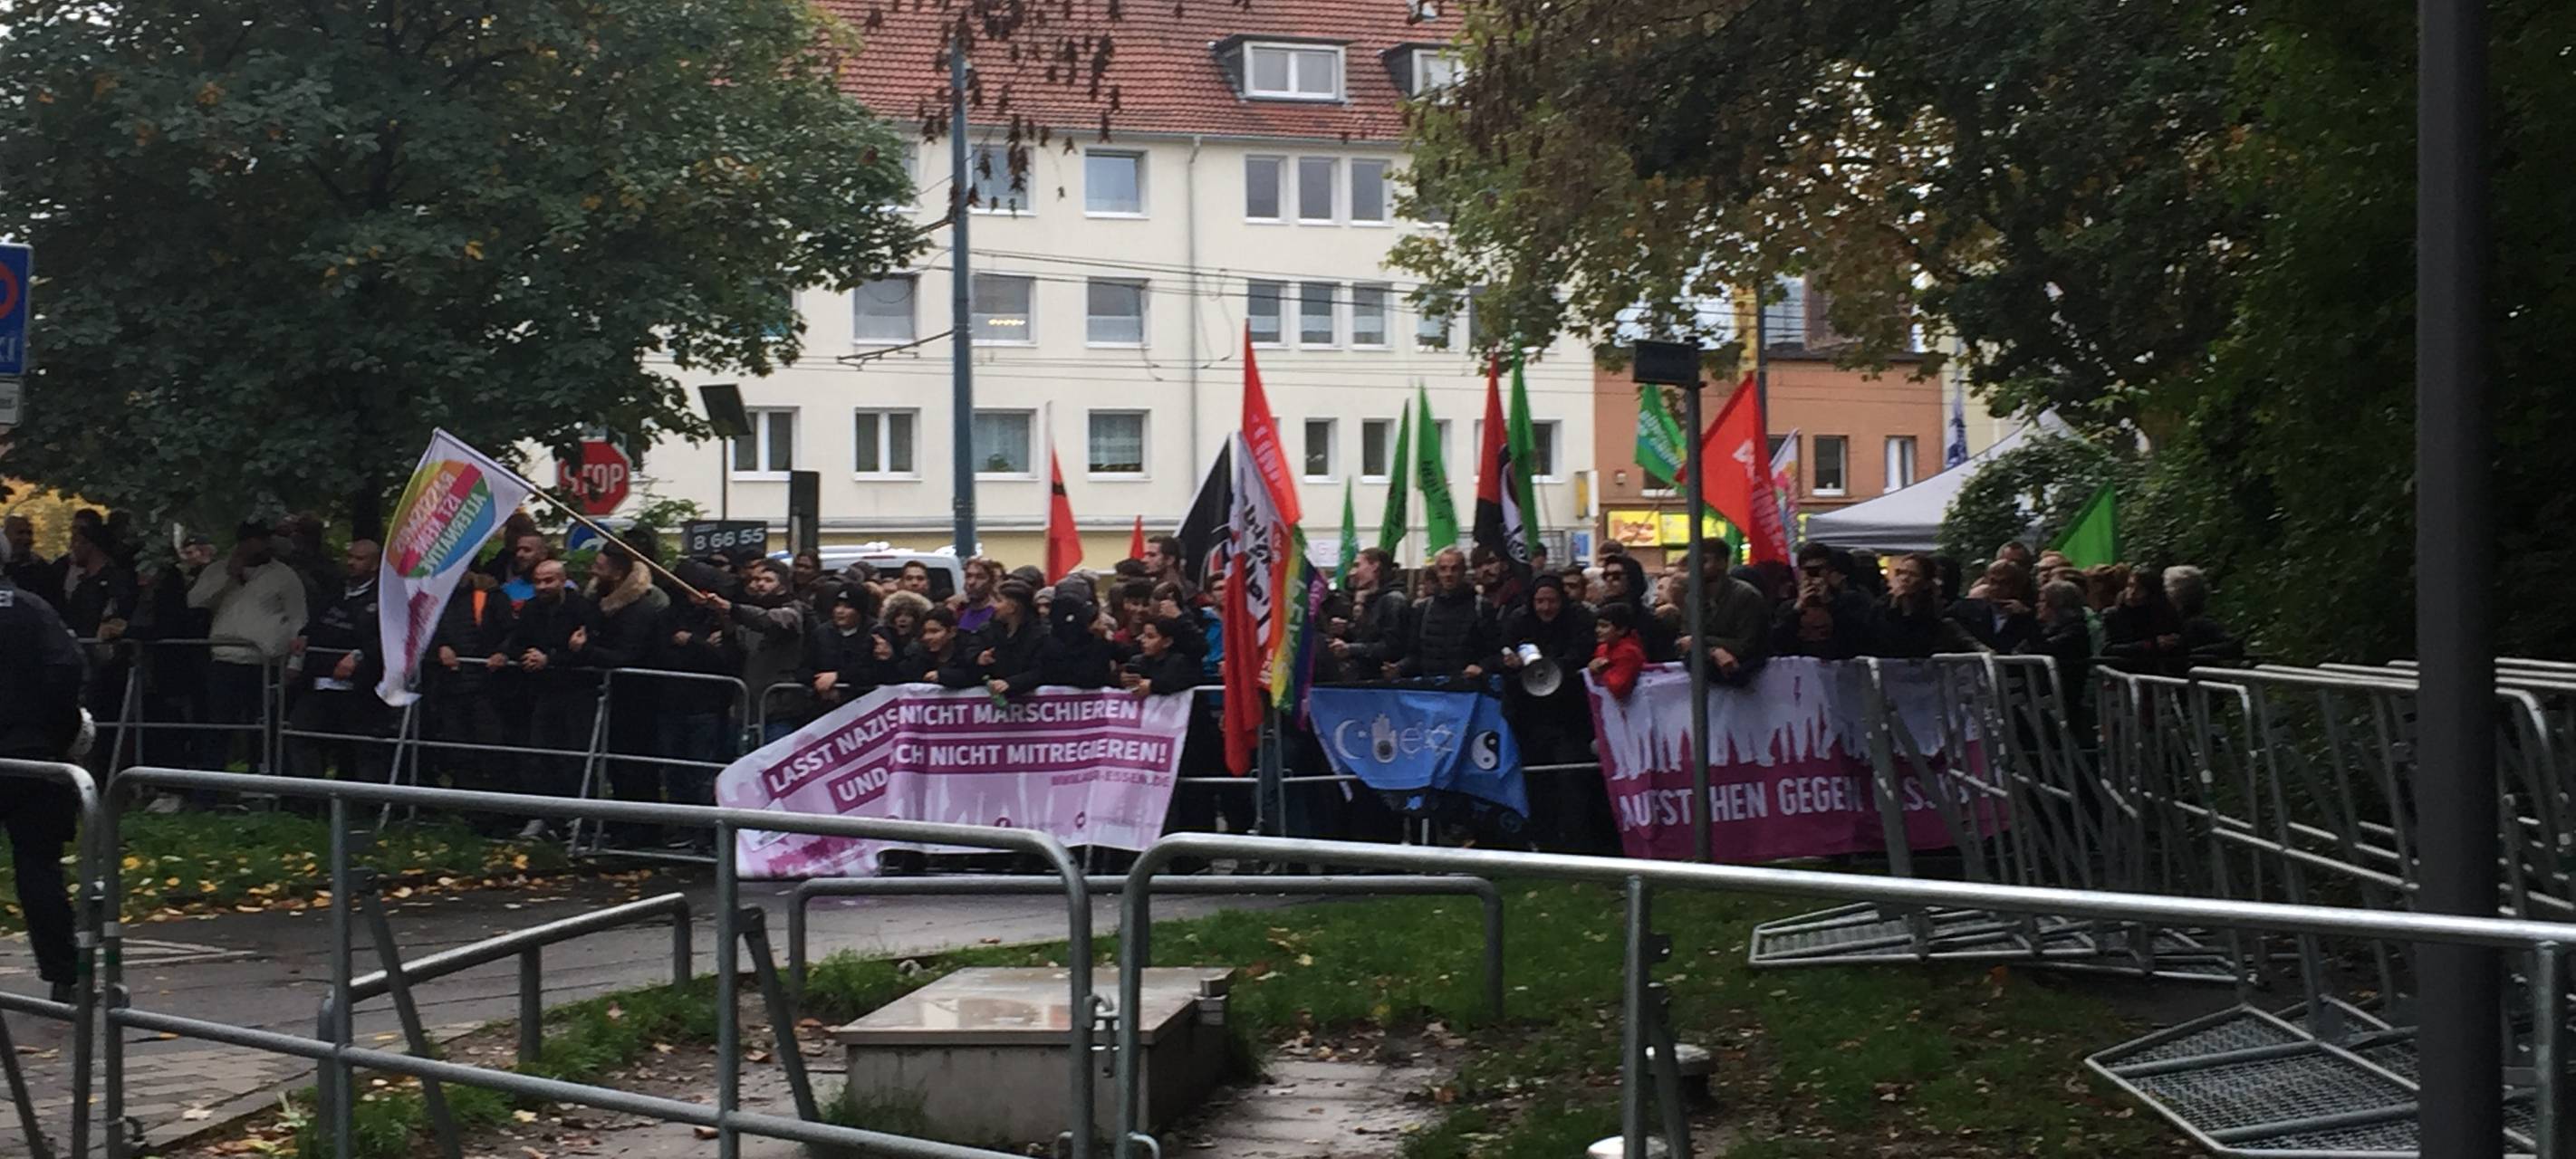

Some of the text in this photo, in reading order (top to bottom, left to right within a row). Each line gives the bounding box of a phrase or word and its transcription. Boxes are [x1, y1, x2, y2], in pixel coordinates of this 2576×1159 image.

[769, 698, 1138, 793] LASST NAZIS NICHT MARSCHIEREN
[837, 766, 889, 803] UND
[929, 744, 1001, 766] NICHT
[1006, 737, 1168, 764] MITREGIEREN!
[1617, 780, 1768, 831] AUFSTHEN
